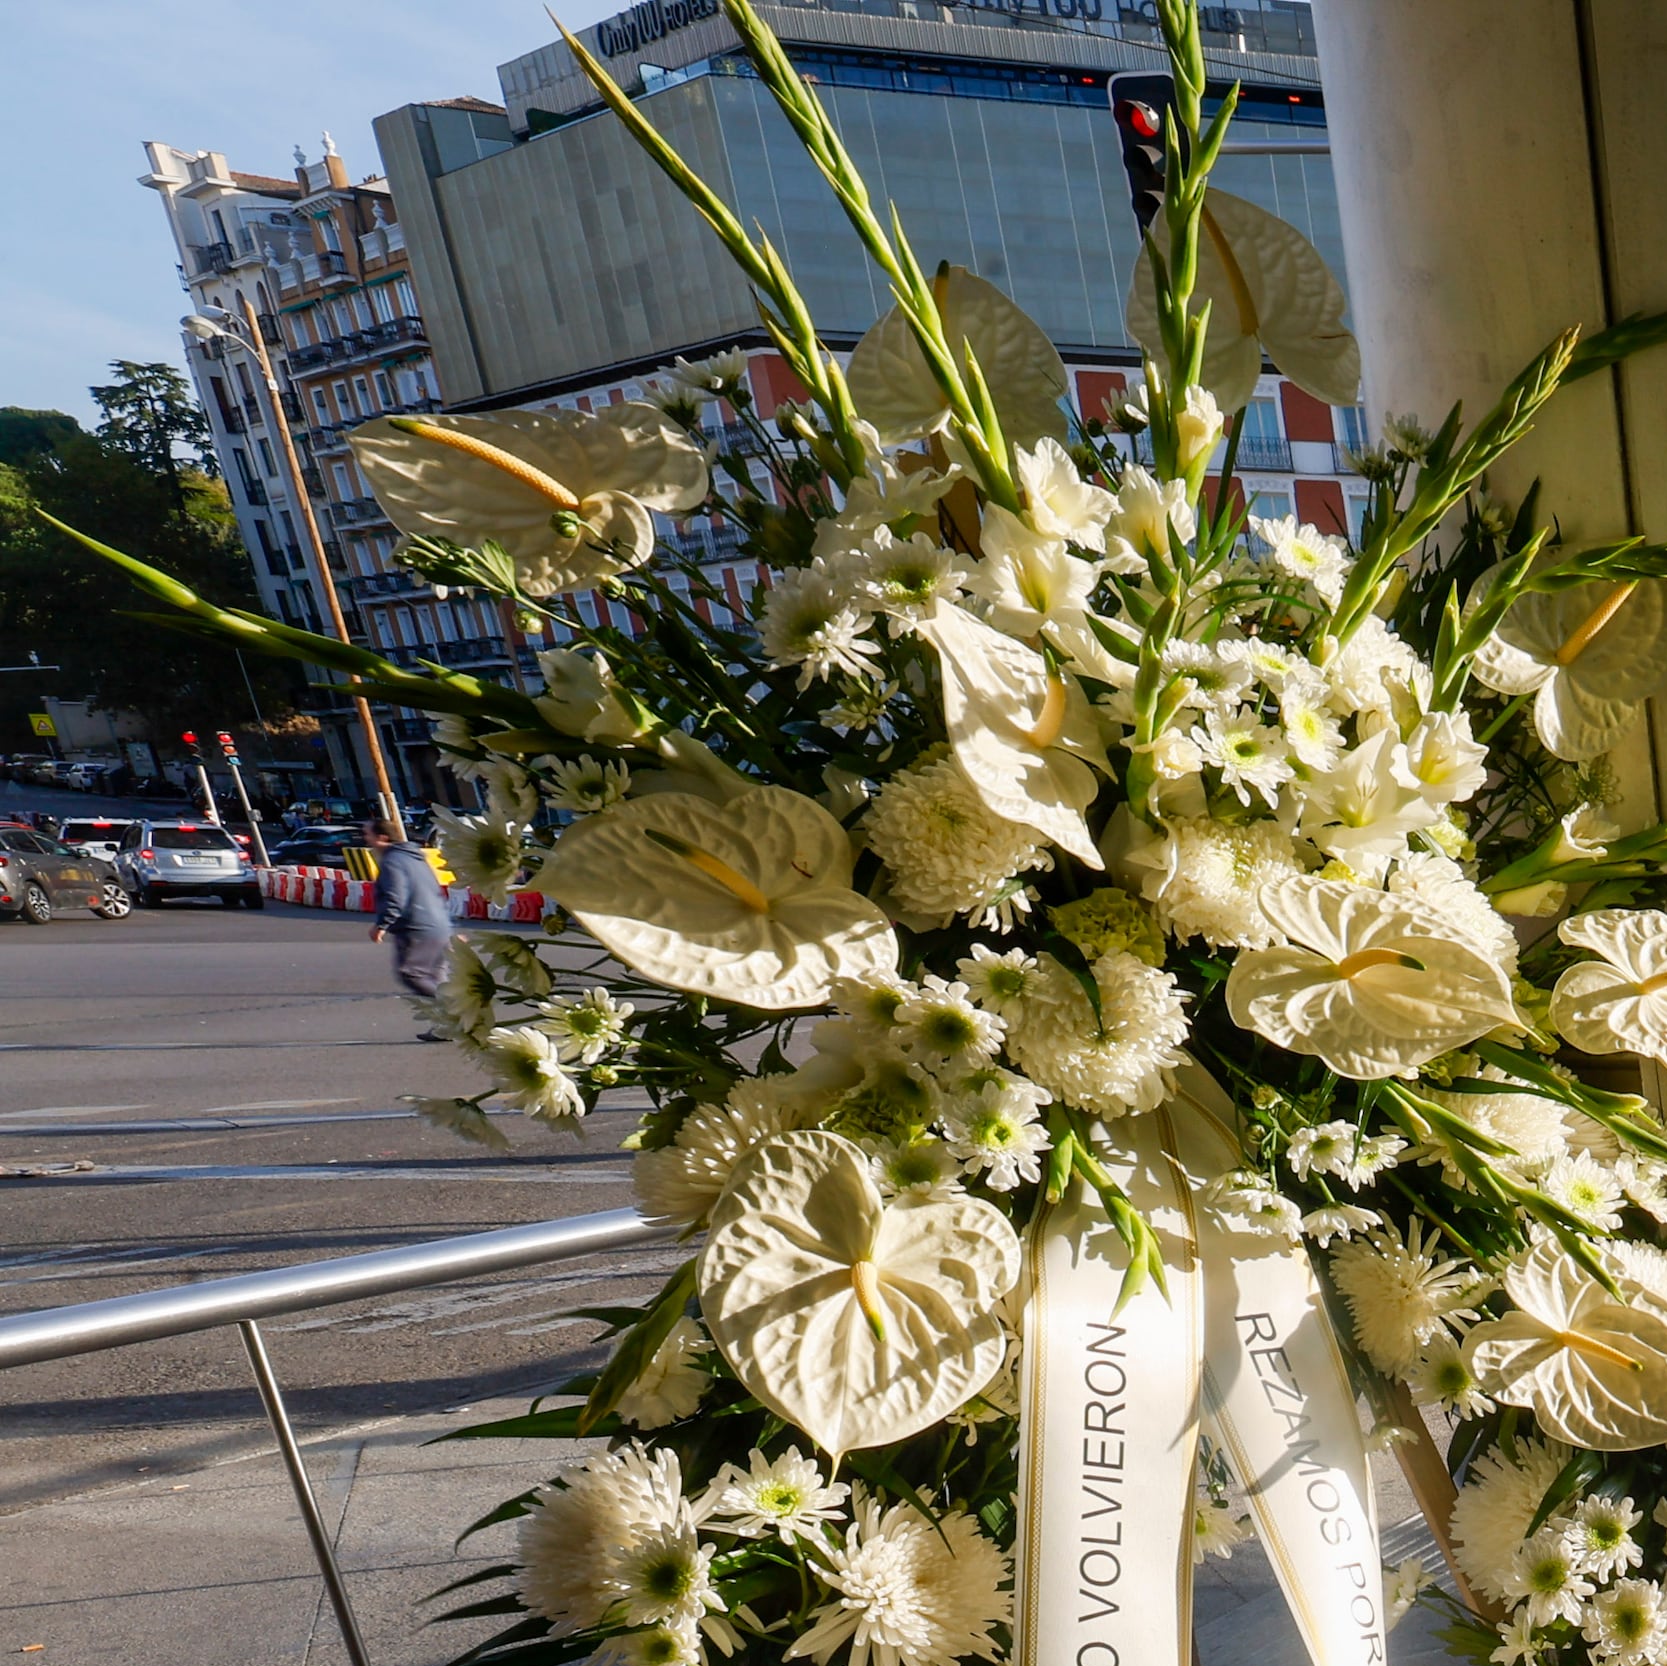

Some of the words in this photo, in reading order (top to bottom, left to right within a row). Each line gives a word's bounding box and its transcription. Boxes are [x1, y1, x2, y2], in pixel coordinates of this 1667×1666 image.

[597, 12, 640, 57] Only
[630, 0, 667, 44] YOU
[1079, 1322, 1127, 1622] VOLVIERON
[1235, 1312, 1354, 1546] REZAMOS
[1335, 1562, 1383, 1666] POR
